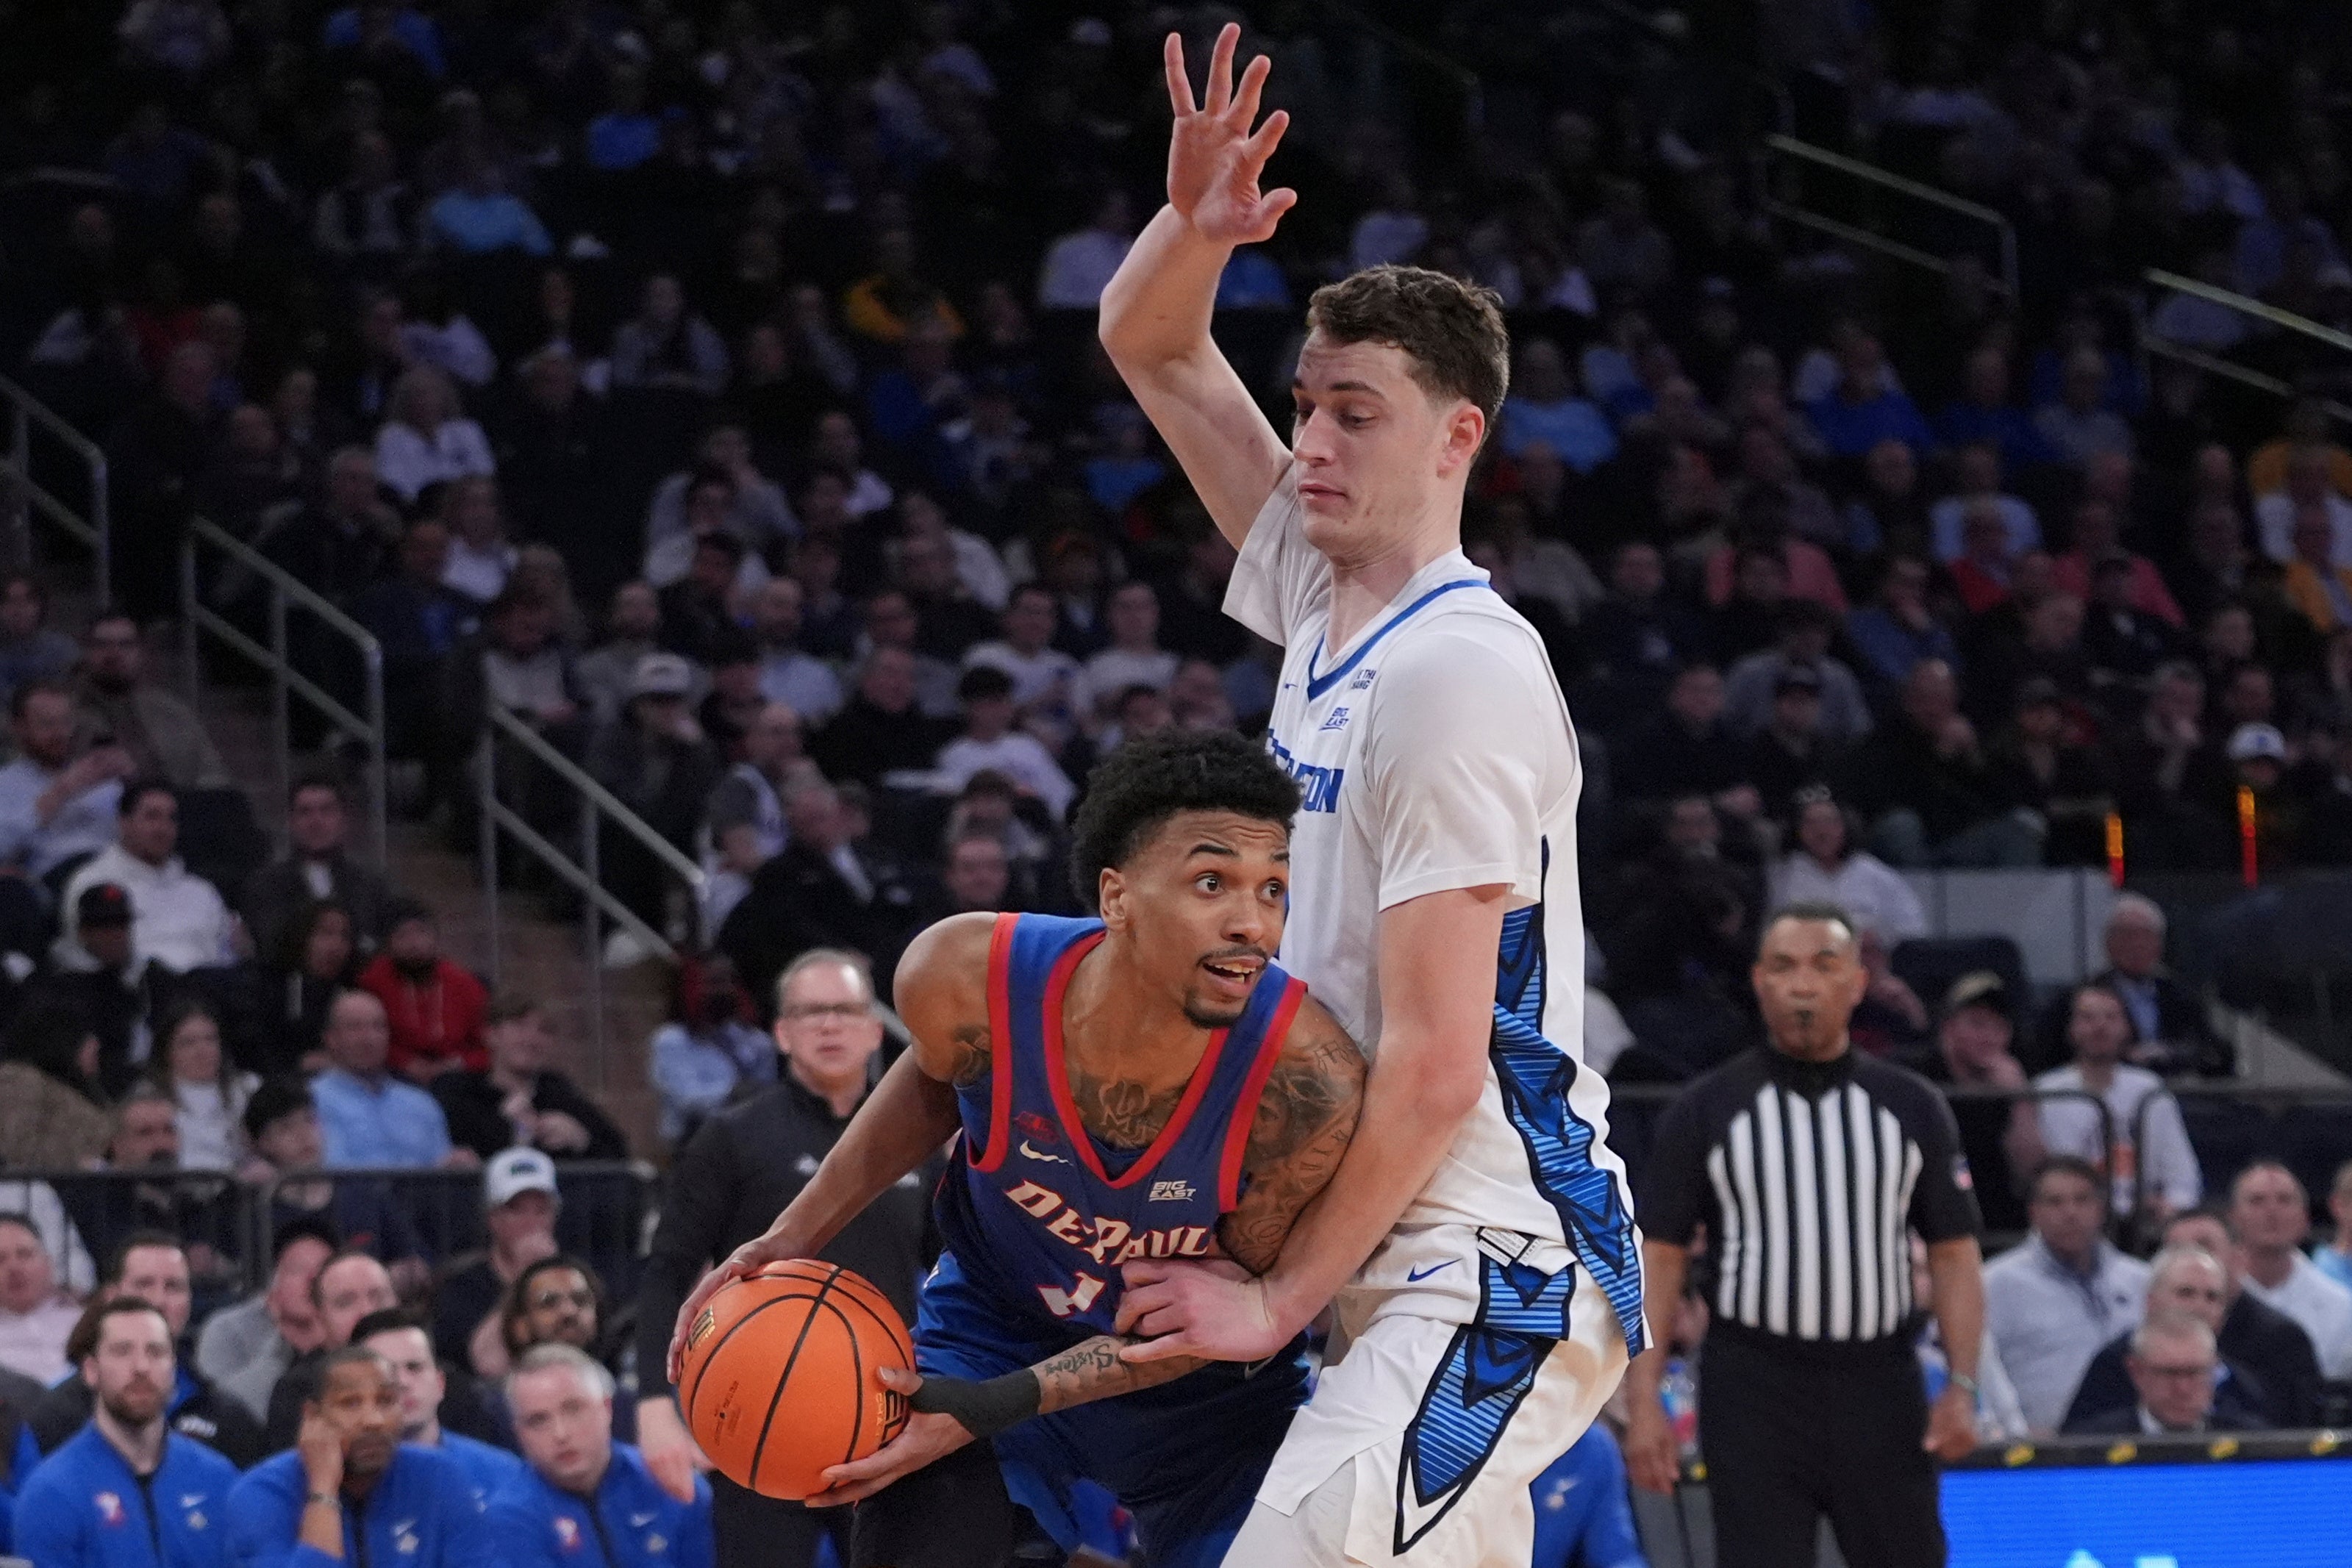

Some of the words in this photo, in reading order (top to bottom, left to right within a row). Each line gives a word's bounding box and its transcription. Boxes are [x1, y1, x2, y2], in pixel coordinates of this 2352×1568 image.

[1332, 707, 1349, 717] BIG
[1325, 717, 1349, 726] EAST
[1153, 1180, 1187, 1190] BIG
[1149, 1189, 1196, 1199] EAST
